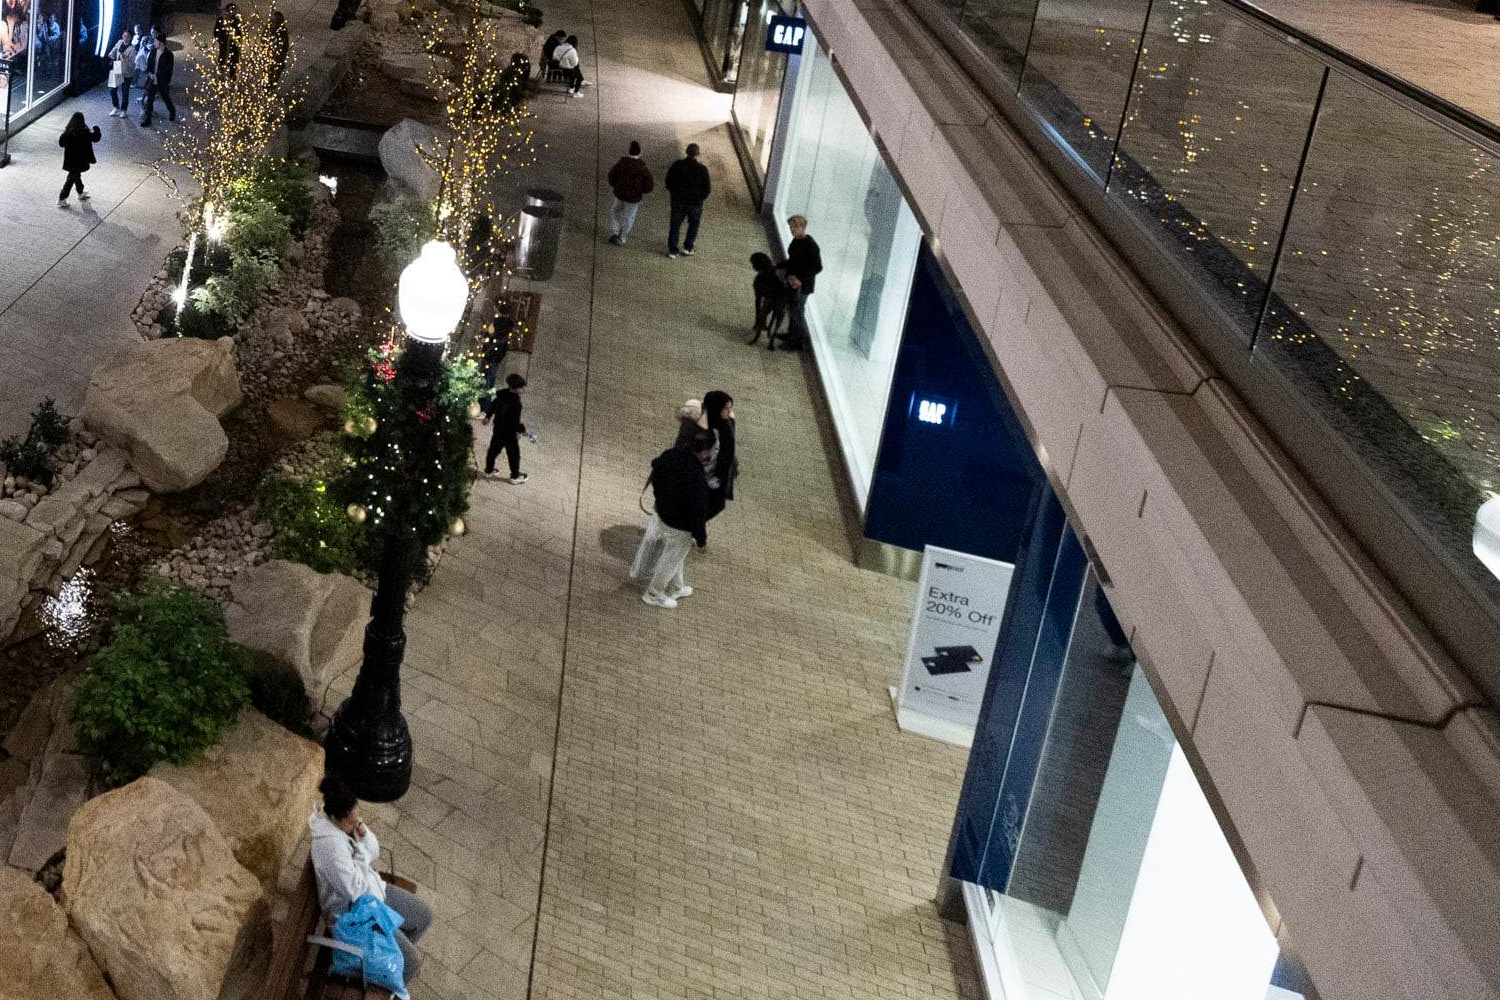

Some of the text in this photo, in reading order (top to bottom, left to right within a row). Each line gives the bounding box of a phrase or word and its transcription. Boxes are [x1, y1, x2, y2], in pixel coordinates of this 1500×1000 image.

[773, 24, 804, 46] GAP
[928, 586, 969, 606] Extra
[925, 601, 962, 619] 20%
